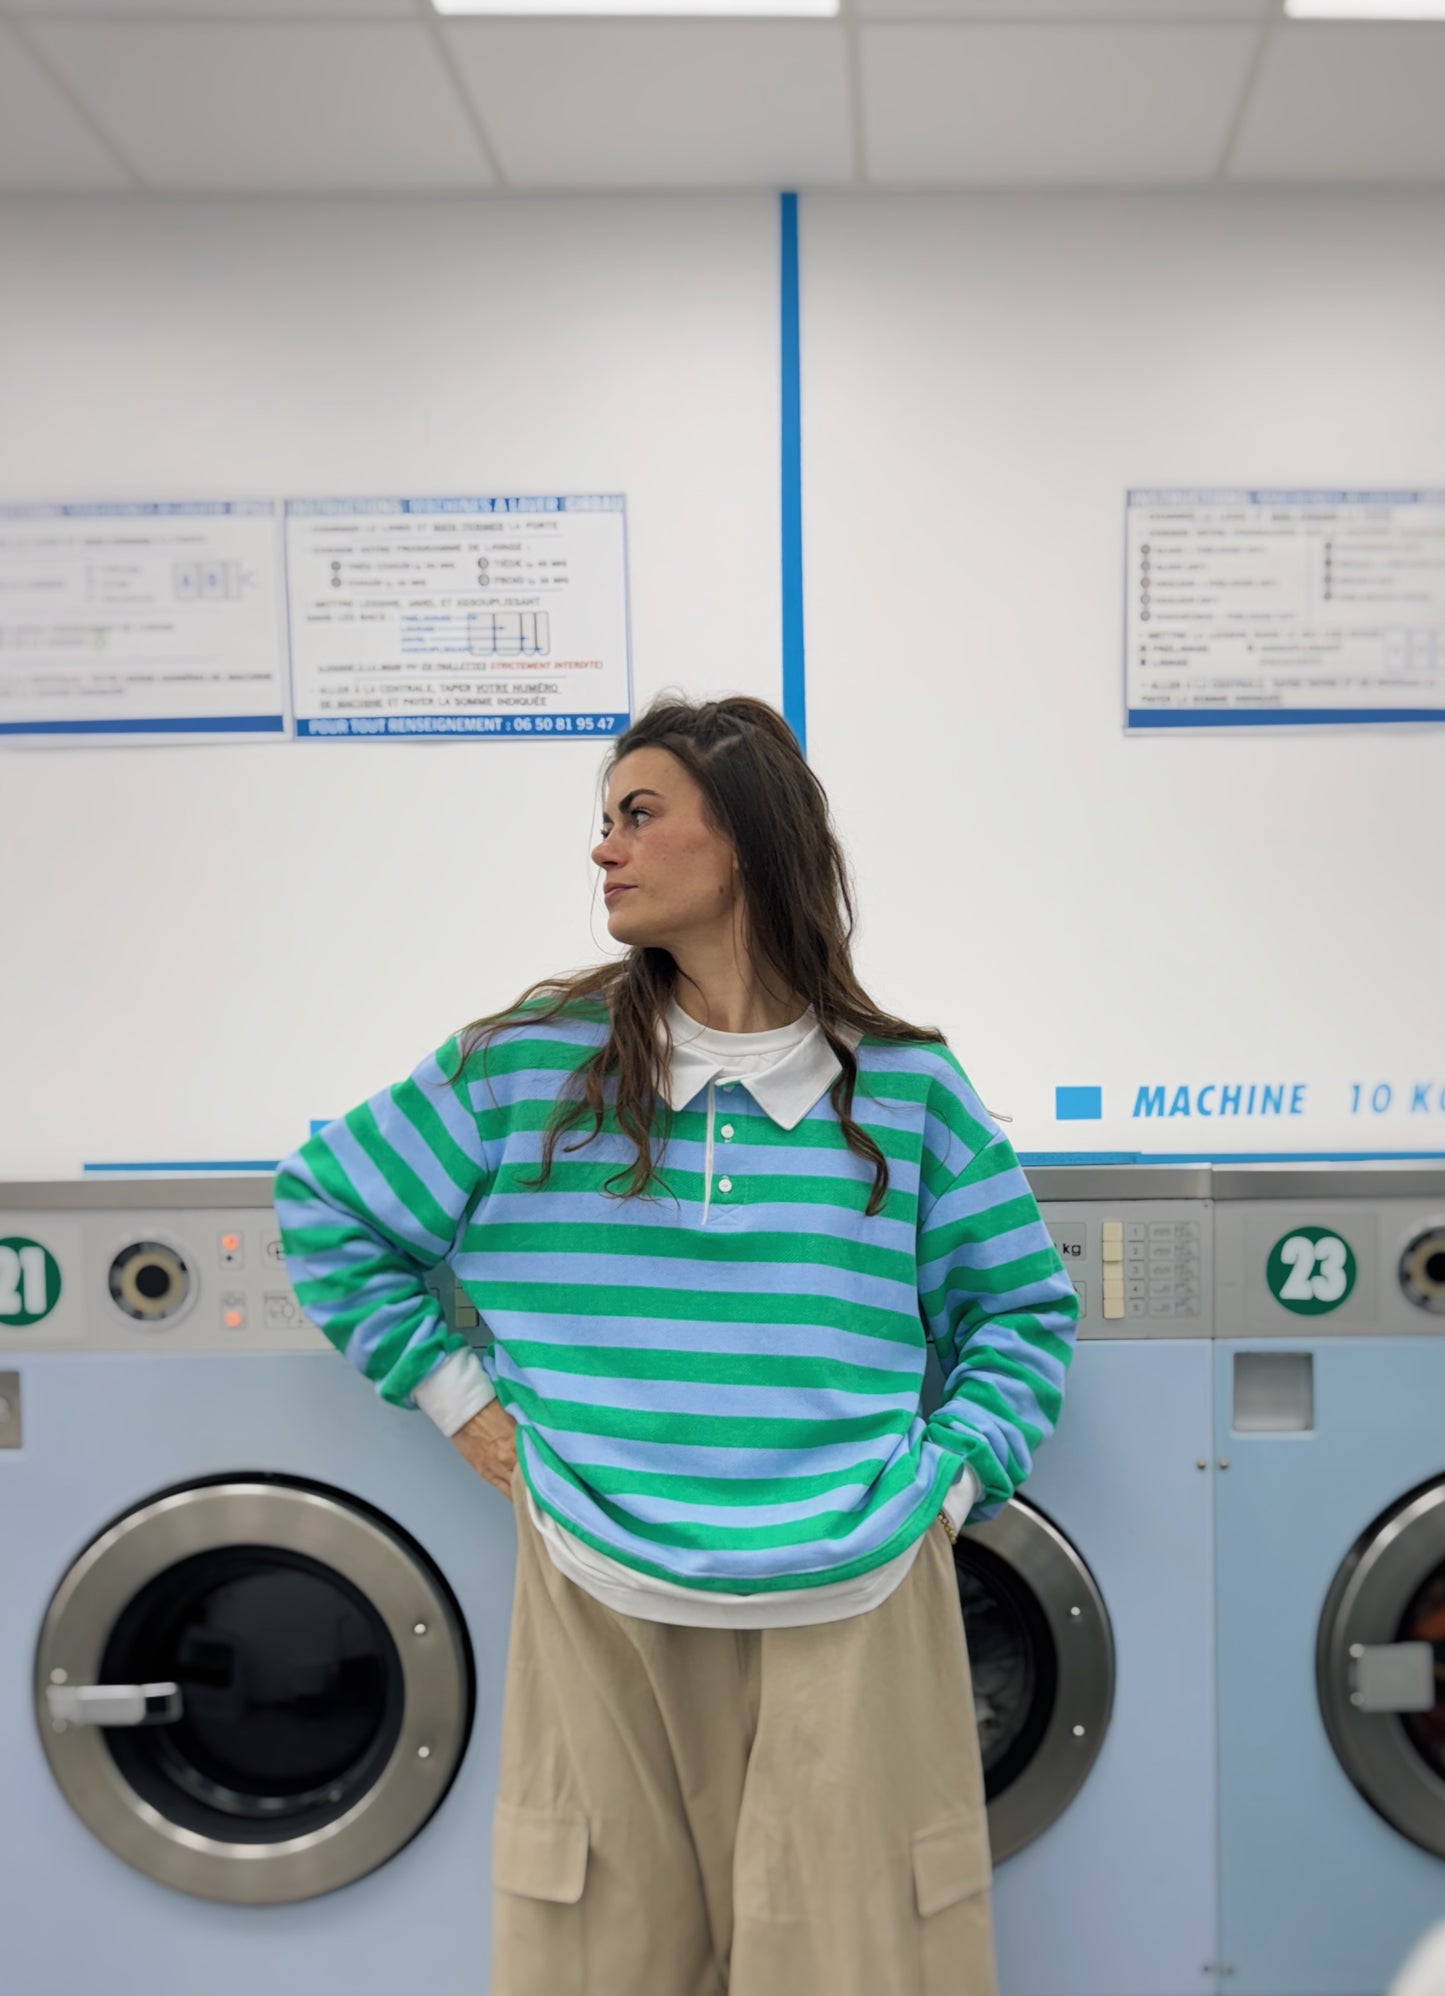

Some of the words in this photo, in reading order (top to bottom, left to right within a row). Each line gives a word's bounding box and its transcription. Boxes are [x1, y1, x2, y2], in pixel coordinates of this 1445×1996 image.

[490, 661, 551, 671] STRICTEMENT
[476, 683, 508, 694] VOTRE
[513, 682, 559, 694] NUMÉRO
[455, 698, 492, 706] SOMME
[497, 696, 547, 706] INDIQUÉE
[308, 718, 349, 735] POUR
[351, 718, 386, 735] TOUT
[387, 717, 503, 734] RENSEIGNEMENT
[513, 717, 533, 732] 06
[535, 717, 552, 732] 50
[555, 717, 572, 731] 81
[576, 717, 594, 731] 95
[597, 717, 615, 731] 47
[1132, 1085, 1307, 1118] MACHINE
[1351, 1084, 1392, 1113] 10
[1412, 1084, 1445, 1113] K
[1063, 1243, 1081, 1257] kg
[1279, 1236, 1347, 1302] 23
